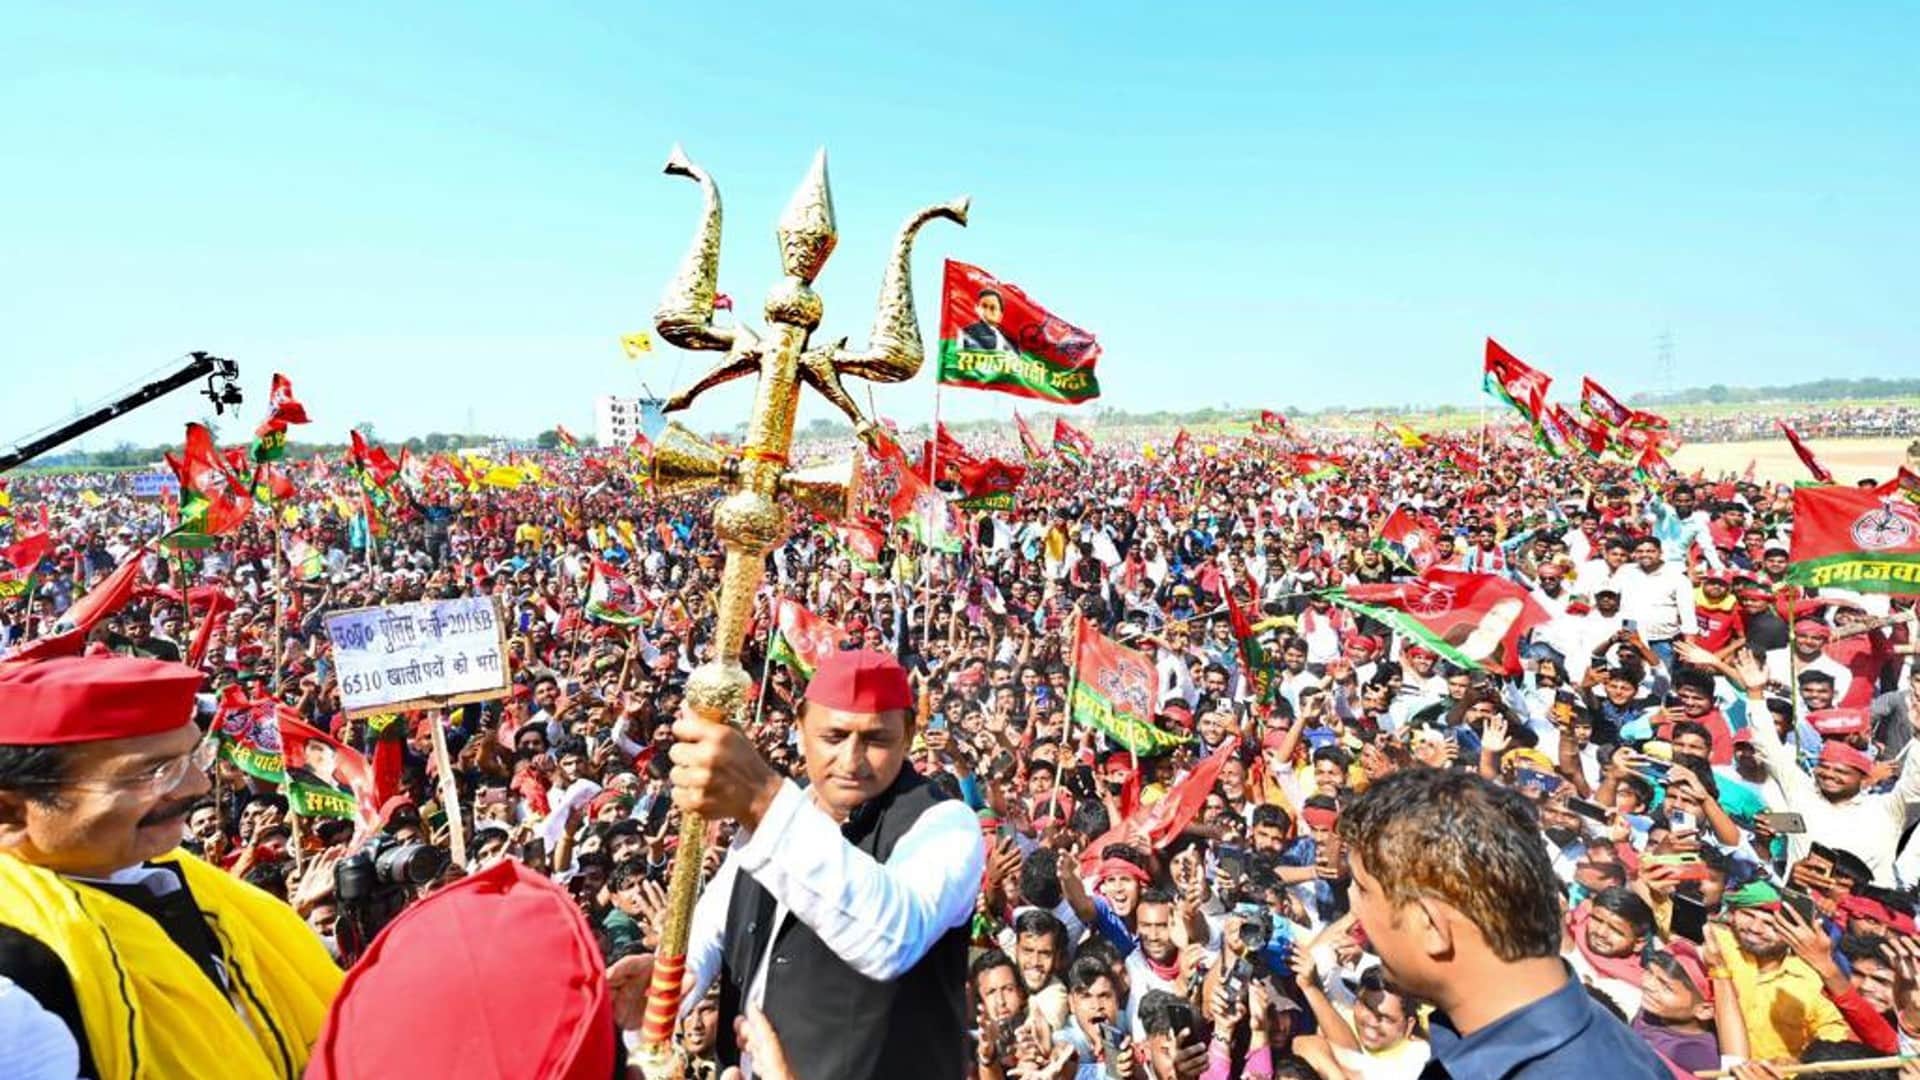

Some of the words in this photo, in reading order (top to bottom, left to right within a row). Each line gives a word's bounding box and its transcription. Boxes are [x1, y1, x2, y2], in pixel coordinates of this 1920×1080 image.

[342, 671, 382, 696] 6510
[386, 658, 421, 687] खाली
[452, 651, 468, 675] को
